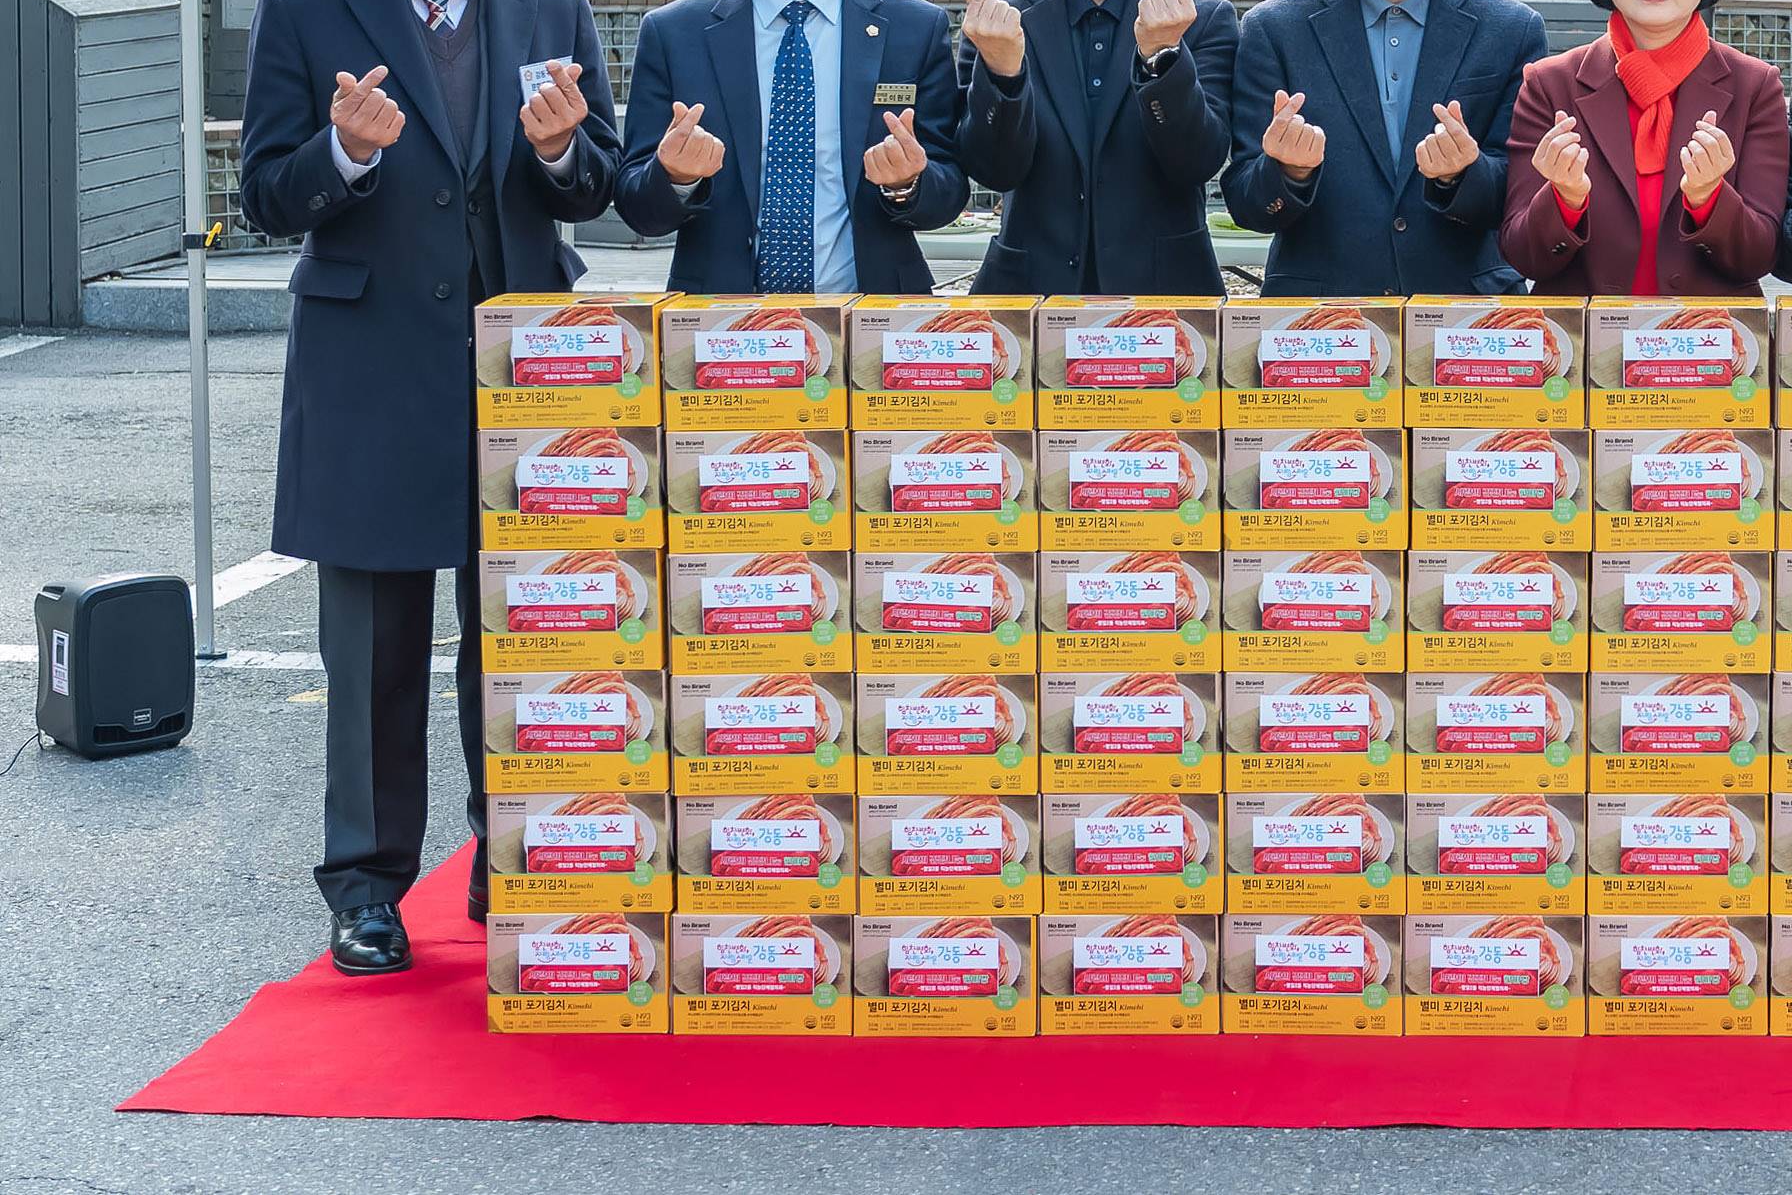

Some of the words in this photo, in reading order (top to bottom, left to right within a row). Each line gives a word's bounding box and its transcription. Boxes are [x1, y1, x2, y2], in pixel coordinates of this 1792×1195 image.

[560, 333, 583, 351] 강동
[1482, 336, 1505, 353] 강동
[680, 396, 699, 406] 별미
[703, 395, 742, 406] 포기김치
[1238, 394, 1256, 405] 별미
[1261, 394, 1300, 404] 포기김치
[1607, 394, 1625, 405] 별미
[1630, 394, 1668, 405] 포기김치
[1118, 459, 1141, 477] 강동
[870, 518, 888, 528] 별미
[893, 518, 932, 528] 포기김치
[1427, 515, 1445, 525] 별미
[1450, 515, 1488, 526] 포기김치
[750, 583, 773, 601] 강동
[496, 638, 514, 649] 별미
[519, 637, 558, 648] 포기김치
[1057, 637, 1075, 648] 별미
[1080, 637, 1119, 648] 포기김치
[1242, 759, 1260, 769] 별미
[1265, 758, 1304, 769] 포기김치
[1606, 759, 1624, 770] 별미
[1629, 759, 1668, 770] 포기김치
[1302, 824, 1324, 841] 강동
[693, 881, 711, 891] 별미
[715, 881, 754, 891] 포기김치
[938, 946, 961, 963] 강동
[503, 1000, 521, 1011] 별미
[526, 1000, 565, 1010] 포기김치
[1420, 1001, 1439, 1012] 별미
[1443, 1002, 1482, 1012] 포기김치
